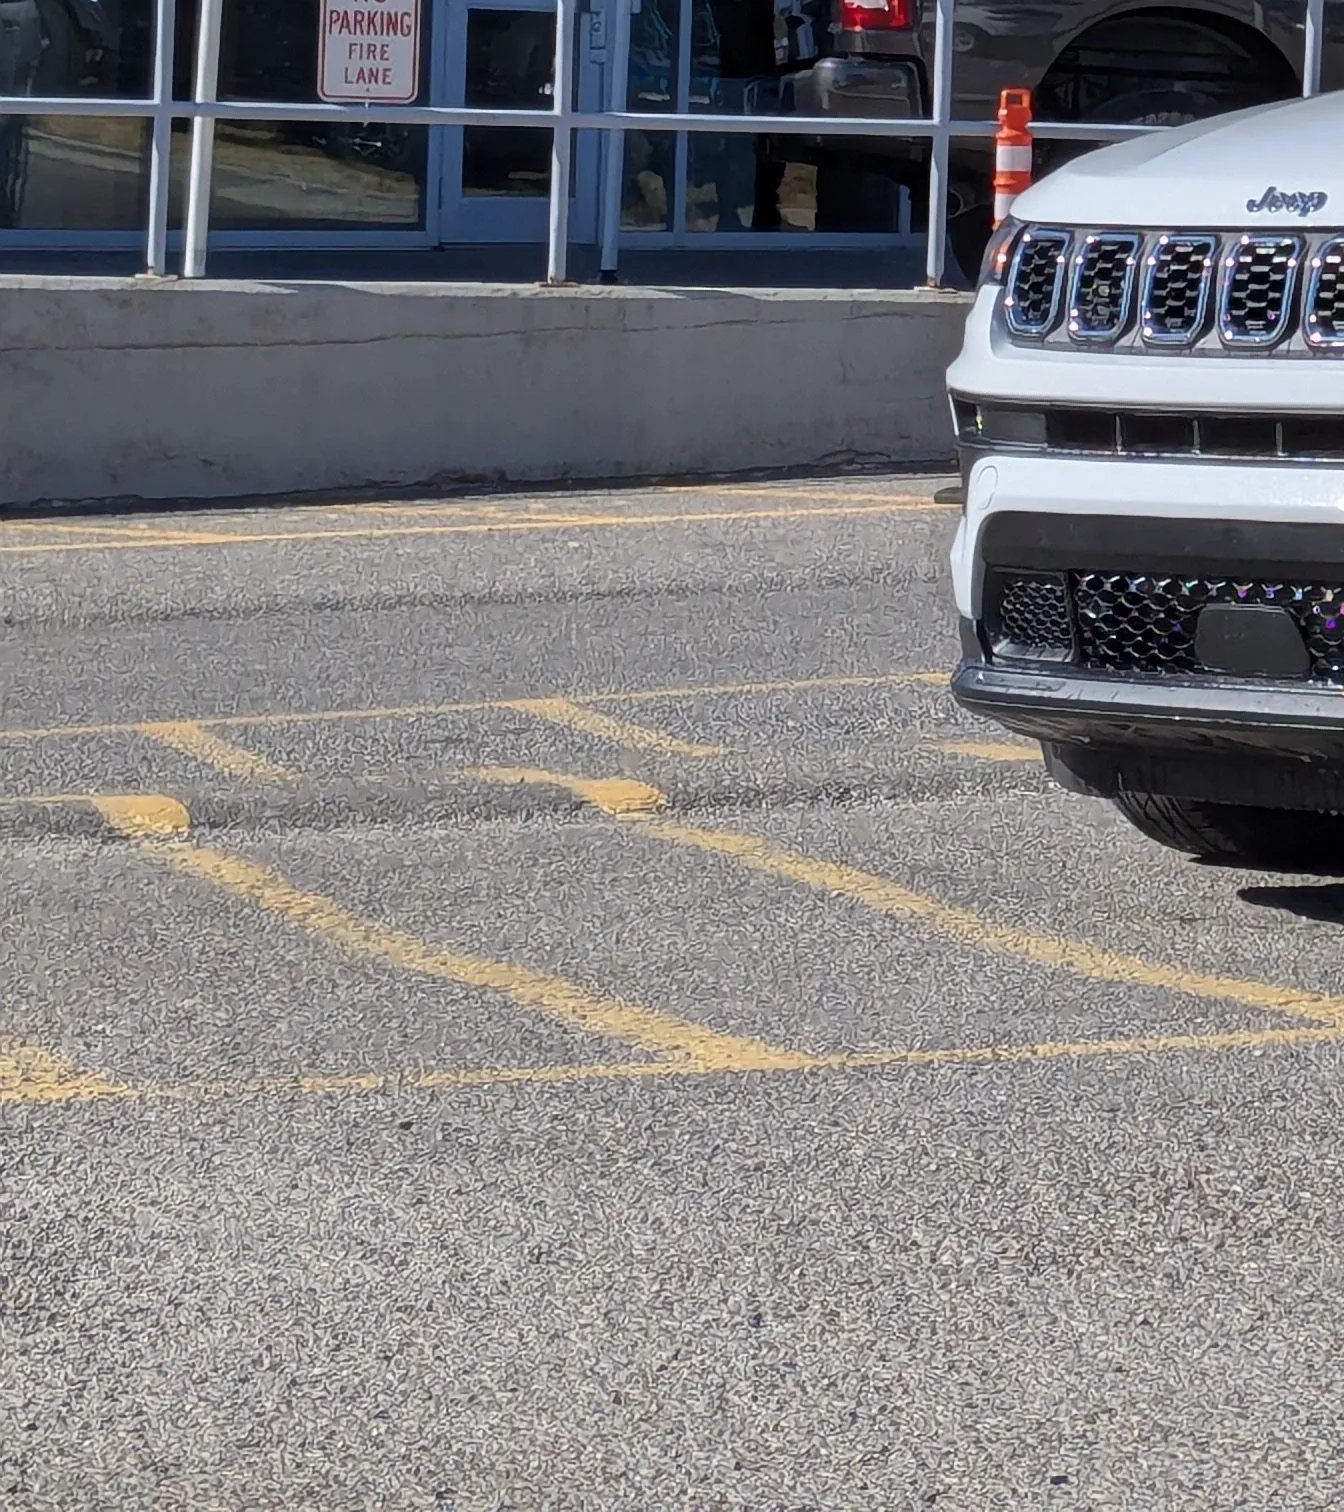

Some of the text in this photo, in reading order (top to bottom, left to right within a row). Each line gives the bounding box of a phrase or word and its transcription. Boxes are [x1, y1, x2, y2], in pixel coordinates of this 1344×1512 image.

[327, 9, 412, 38] PARKING
[347, 42, 390, 62] FIRE
[343, 66, 393, 86] LANE
[1246, 185, 1329, 218] Jeep
